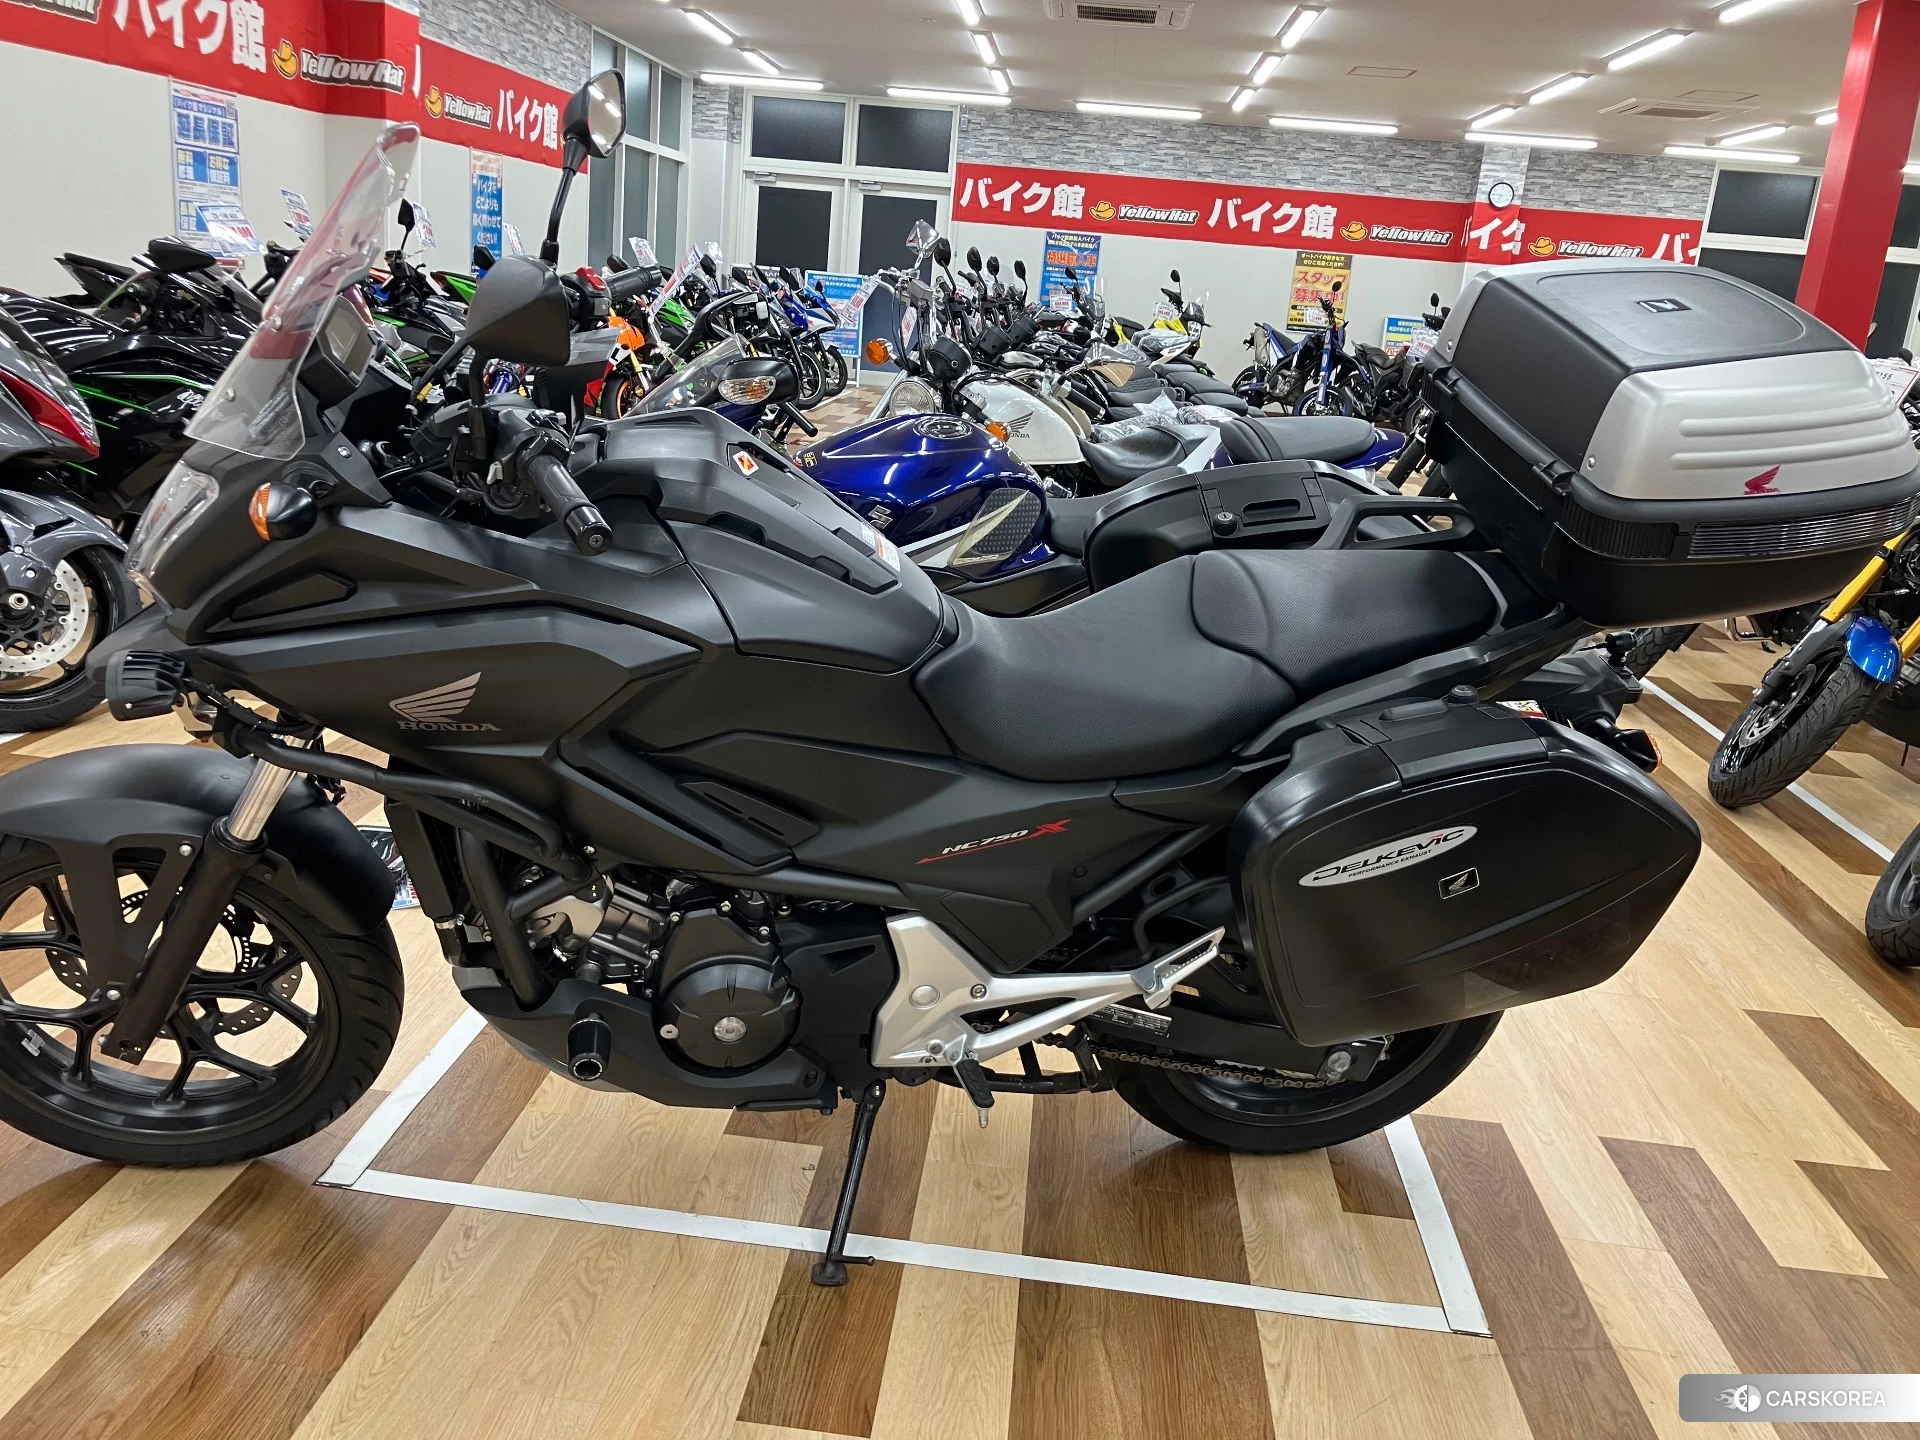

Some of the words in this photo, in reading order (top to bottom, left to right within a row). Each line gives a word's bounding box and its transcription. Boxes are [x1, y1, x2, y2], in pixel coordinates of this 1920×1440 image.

[444, 94, 491, 125] YellowHat
[497, 89, 559, 150] バイク館
[959, 178, 1086, 219] バイク館
[1118, 205, 1198, 224] YellowHat
[1207, 198, 1338, 240] バイク館
[1371, 226, 1450, 243] YellowHat
[1297, 270, 1348, 285] スタッフ
[396, 720, 502, 732] HONDA
[1348, 860, 1400, 878] PERFORMANCE
[1400, 849, 1433, 863] EXHAUST
